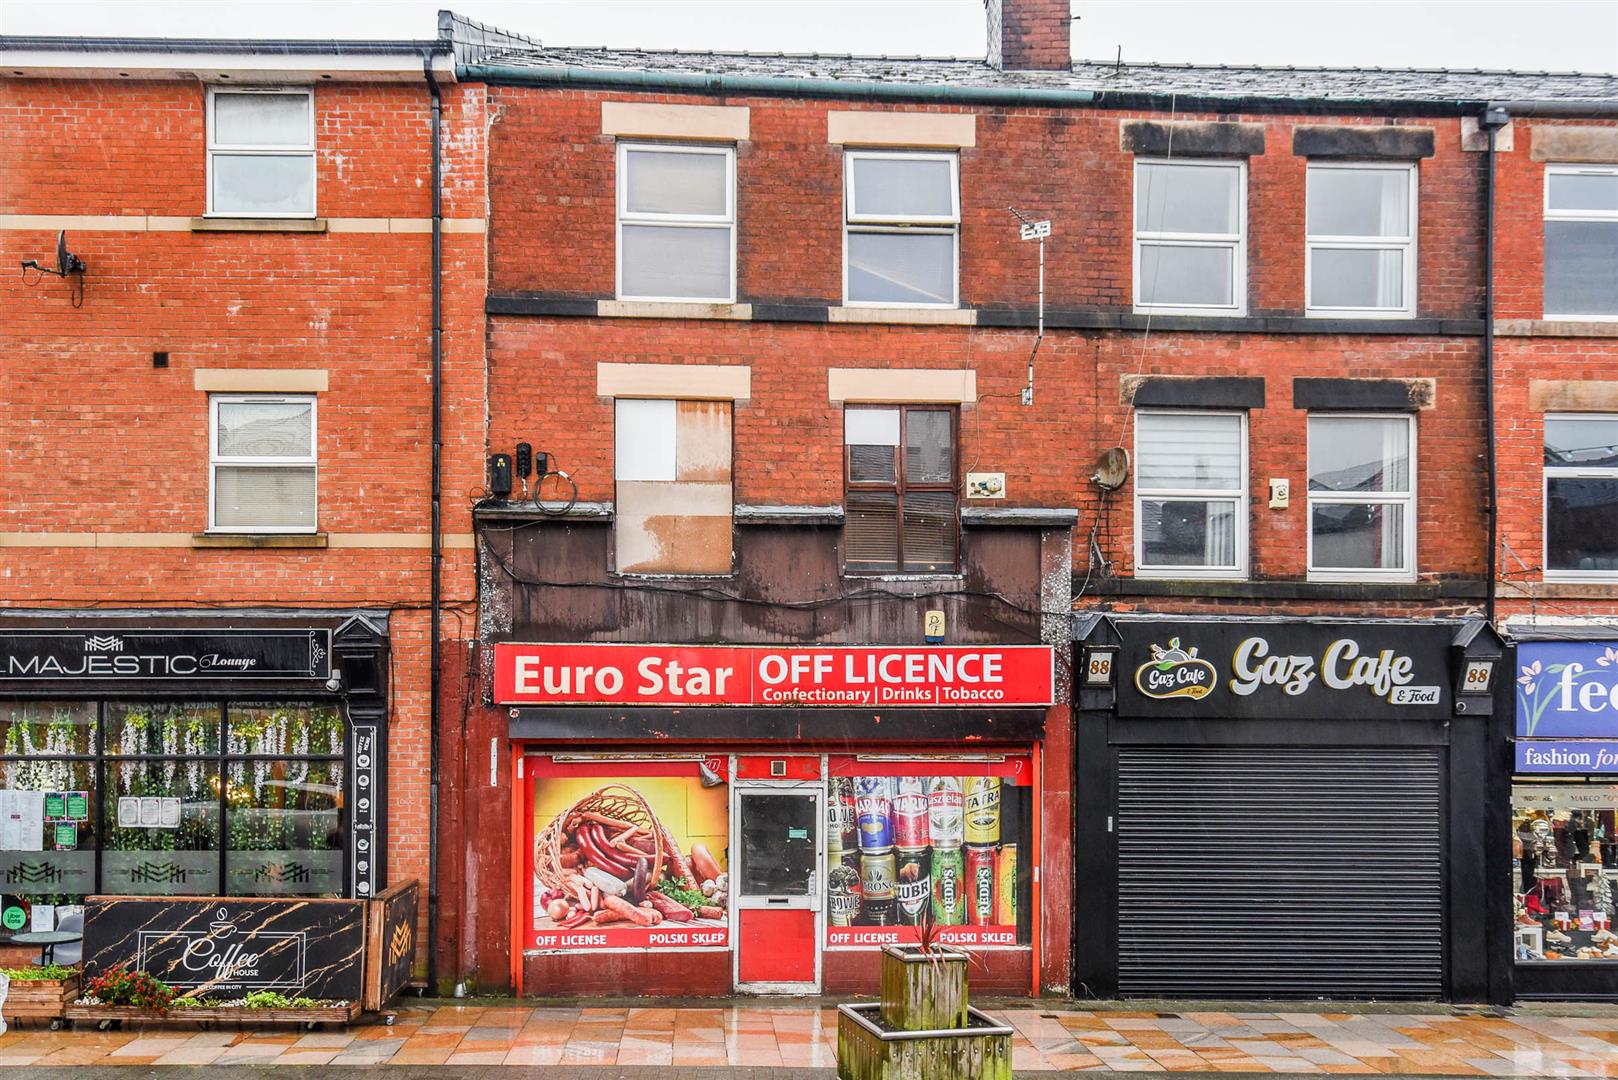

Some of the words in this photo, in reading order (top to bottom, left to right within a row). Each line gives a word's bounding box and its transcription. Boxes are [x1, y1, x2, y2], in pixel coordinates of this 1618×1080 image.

[9, 655, 197, 674] MAJESTIC
[200, 653, 256, 671] Lounge
[759, 654, 833, 684] OFF
[845, 653, 1003, 684] LICENCE
[1090, 660, 1110, 675] 88
[1229, 637, 1316, 696] Gaz
[1321, 638, 1415, 697] Cafe
[514, 655, 624, 695] Euro
[637, 656, 733, 696] Star
[1148, 670, 1176, 689] Gaz
[1176, 667, 1205, 684] Cafe
[1467, 669, 1488, 683] 88
[763, 687, 870, 703] Confectionary
[882, 686, 931, 700] Drinks
[942, 686, 1004, 700] Tobacco
[1408, 690, 1435, 702] Food
[1524, 748, 1591, 765] fashion
[536, 936, 557, 946] OFF
[561, 935, 607, 946] LICENSE
[649, 933, 688, 944] POLSKI
[691, 933, 725, 944] SKLEP
[830, 932, 850, 943] OFF
[854, 932, 899, 943] LICENSE
[939, 932, 977, 943] POLSKI
[981, 931, 1014, 943] SKLEP
[183, 937, 259, 980] Coffee
[233, 969, 259, 977] HOUSE
